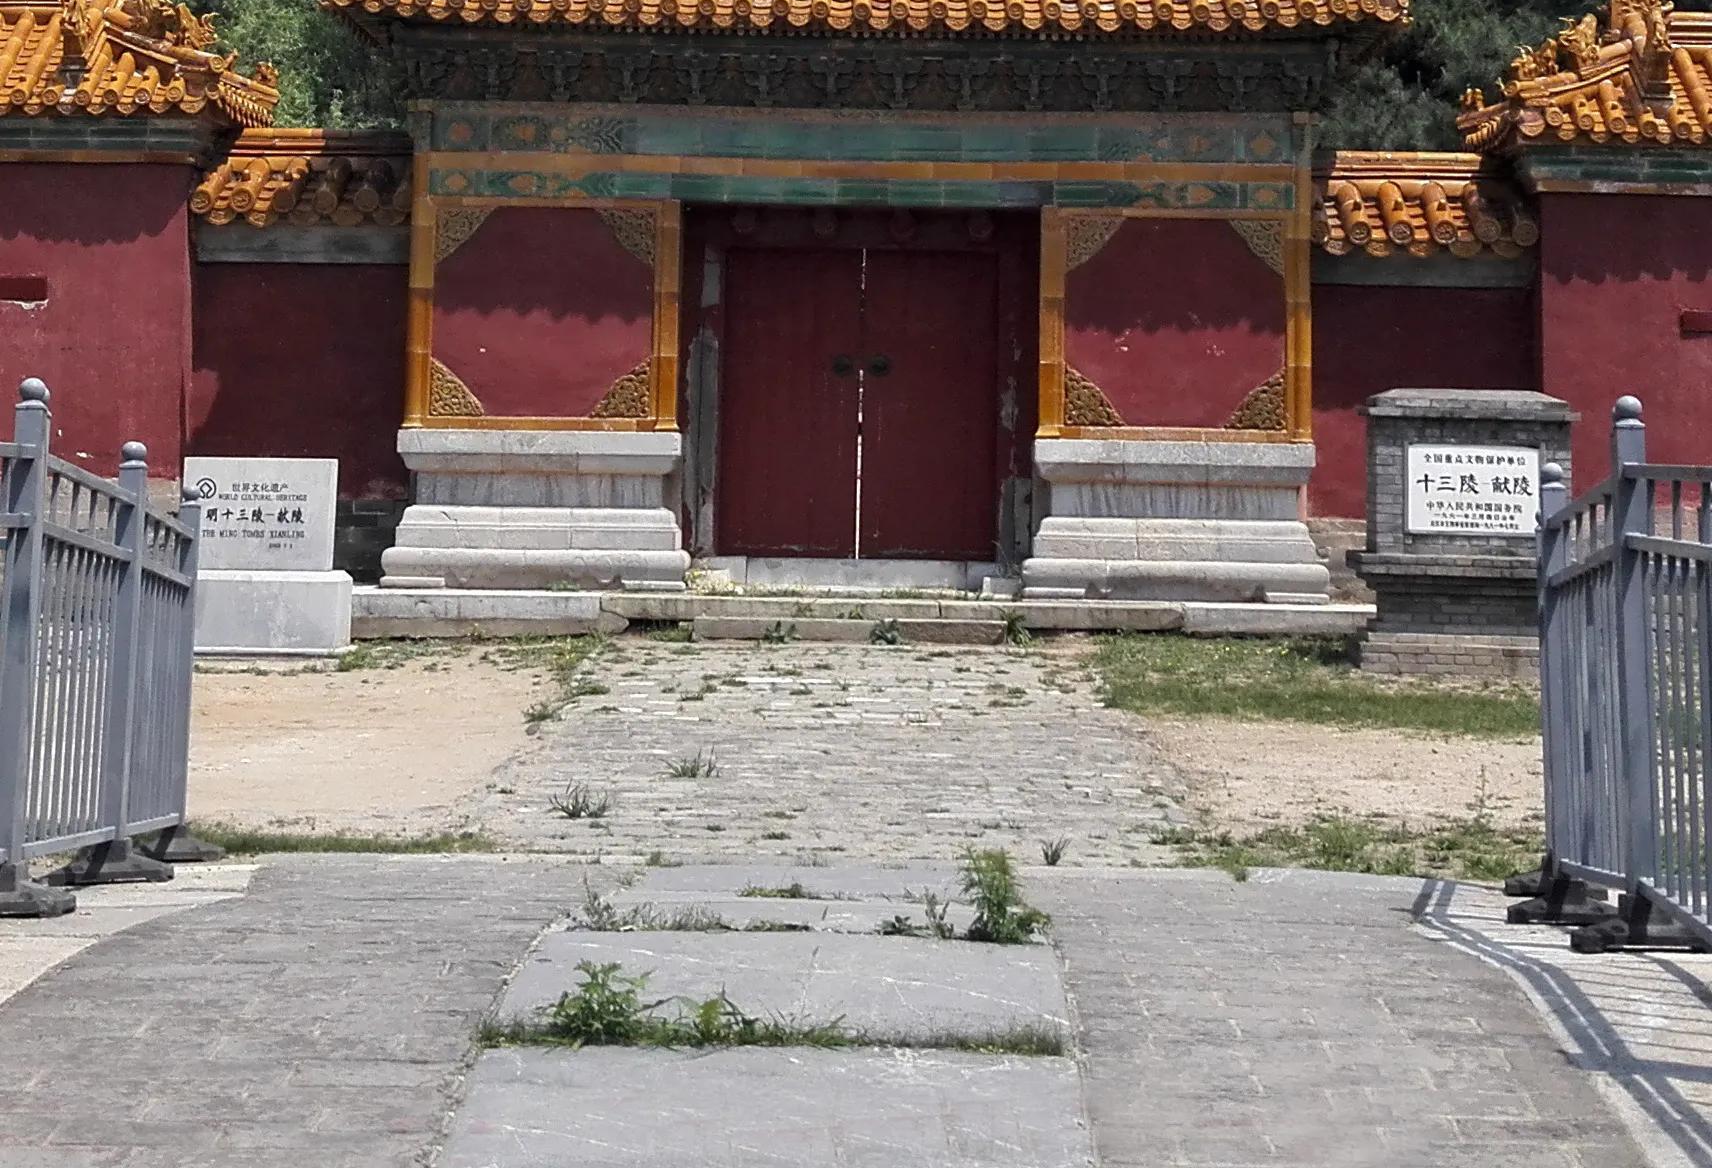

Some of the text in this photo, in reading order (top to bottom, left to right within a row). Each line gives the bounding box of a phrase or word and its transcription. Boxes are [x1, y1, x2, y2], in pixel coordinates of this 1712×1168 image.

[1424, 453, 1526, 466] 全国重点文物保护单位
[232, 482, 289, 493] 世界文化遗产
[218, 493, 308, 502] WORLD CULTURAL HERITAGE
[202, 529, 305, 539] THE MING TOMBS XIANLING
